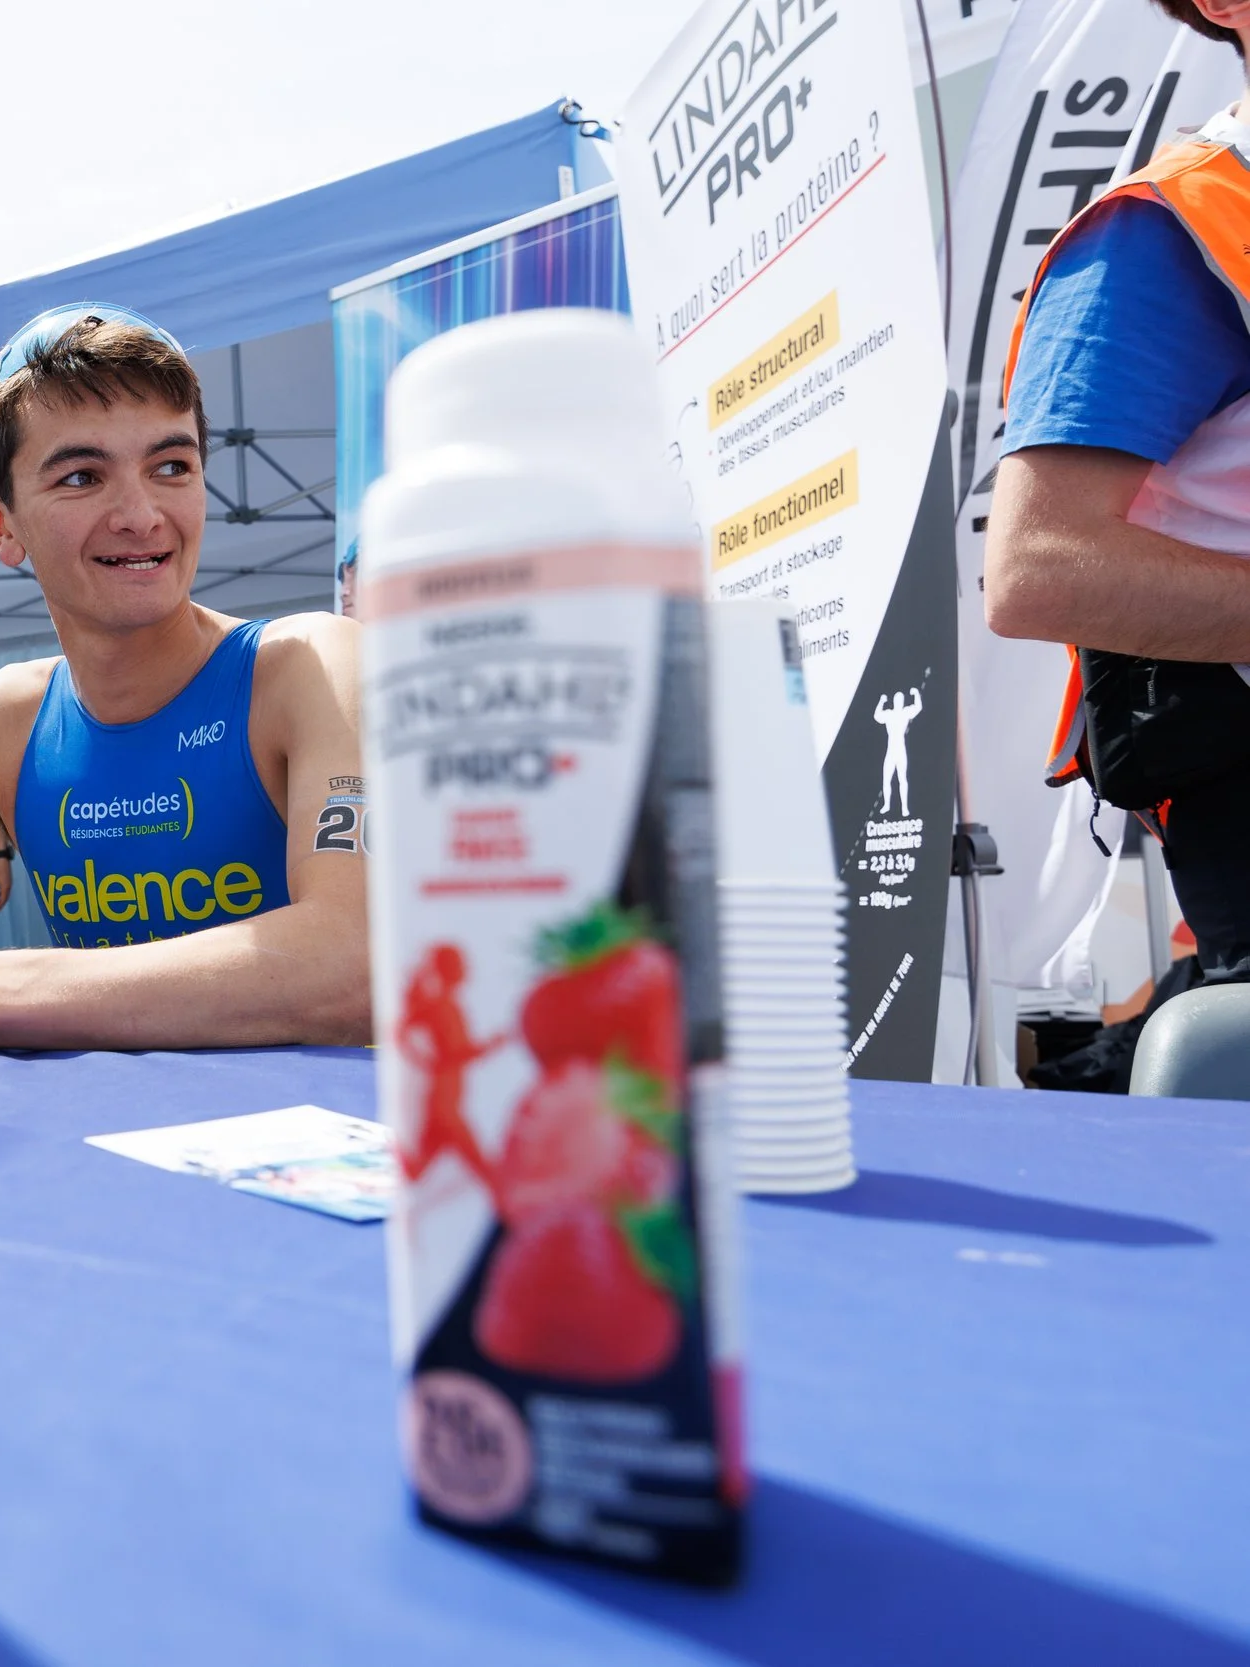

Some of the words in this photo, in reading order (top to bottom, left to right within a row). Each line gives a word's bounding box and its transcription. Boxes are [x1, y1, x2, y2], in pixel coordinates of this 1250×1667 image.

[653, 0, 826, 198] LINDAH
[706, 76, 812, 226] PRO+
[671, 284, 704, 342] quoi
[711, 248, 745, 303] sert
[752, 230, 768, 268] la
[776, 137, 861, 250] protéine
[716, 376, 745, 415] Rôle
[750, 313, 825, 391] structural
[802, 365, 833, 399] et/ou
[836, 323, 894, 375] maintien
[718, 455, 736, 477] des
[738, 434, 770, 464] tissus
[773, 385, 846, 443] musculaires
[719, 523, 748, 556] Rôle
[753, 467, 845, 539] fonctionnel
[719, 566, 768, 598] Transport
[772, 558, 782, 579] et
[786, 535, 843, 573] stockage
[795, 597, 844, 628] nticorps
[178, 720, 226, 752] MAKO
[70, 792, 181, 824] capétudes
[71, 827, 123, 840] RÉSIDENCES
[125, 821, 181, 837] ÉTUDIANTES
[329, 796, 367, 804] TRIATHLO
[866, 818, 923, 838] Croissance
[865, 832, 922, 852] musculaire
[33, 859, 263, 922] valence
[851, 1031, 870, 1057] POUR
[865, 1018, 878, 1036] UN
[873, 988, 895, 1024] ADULTE
[889, 976, 902, 993] DE
